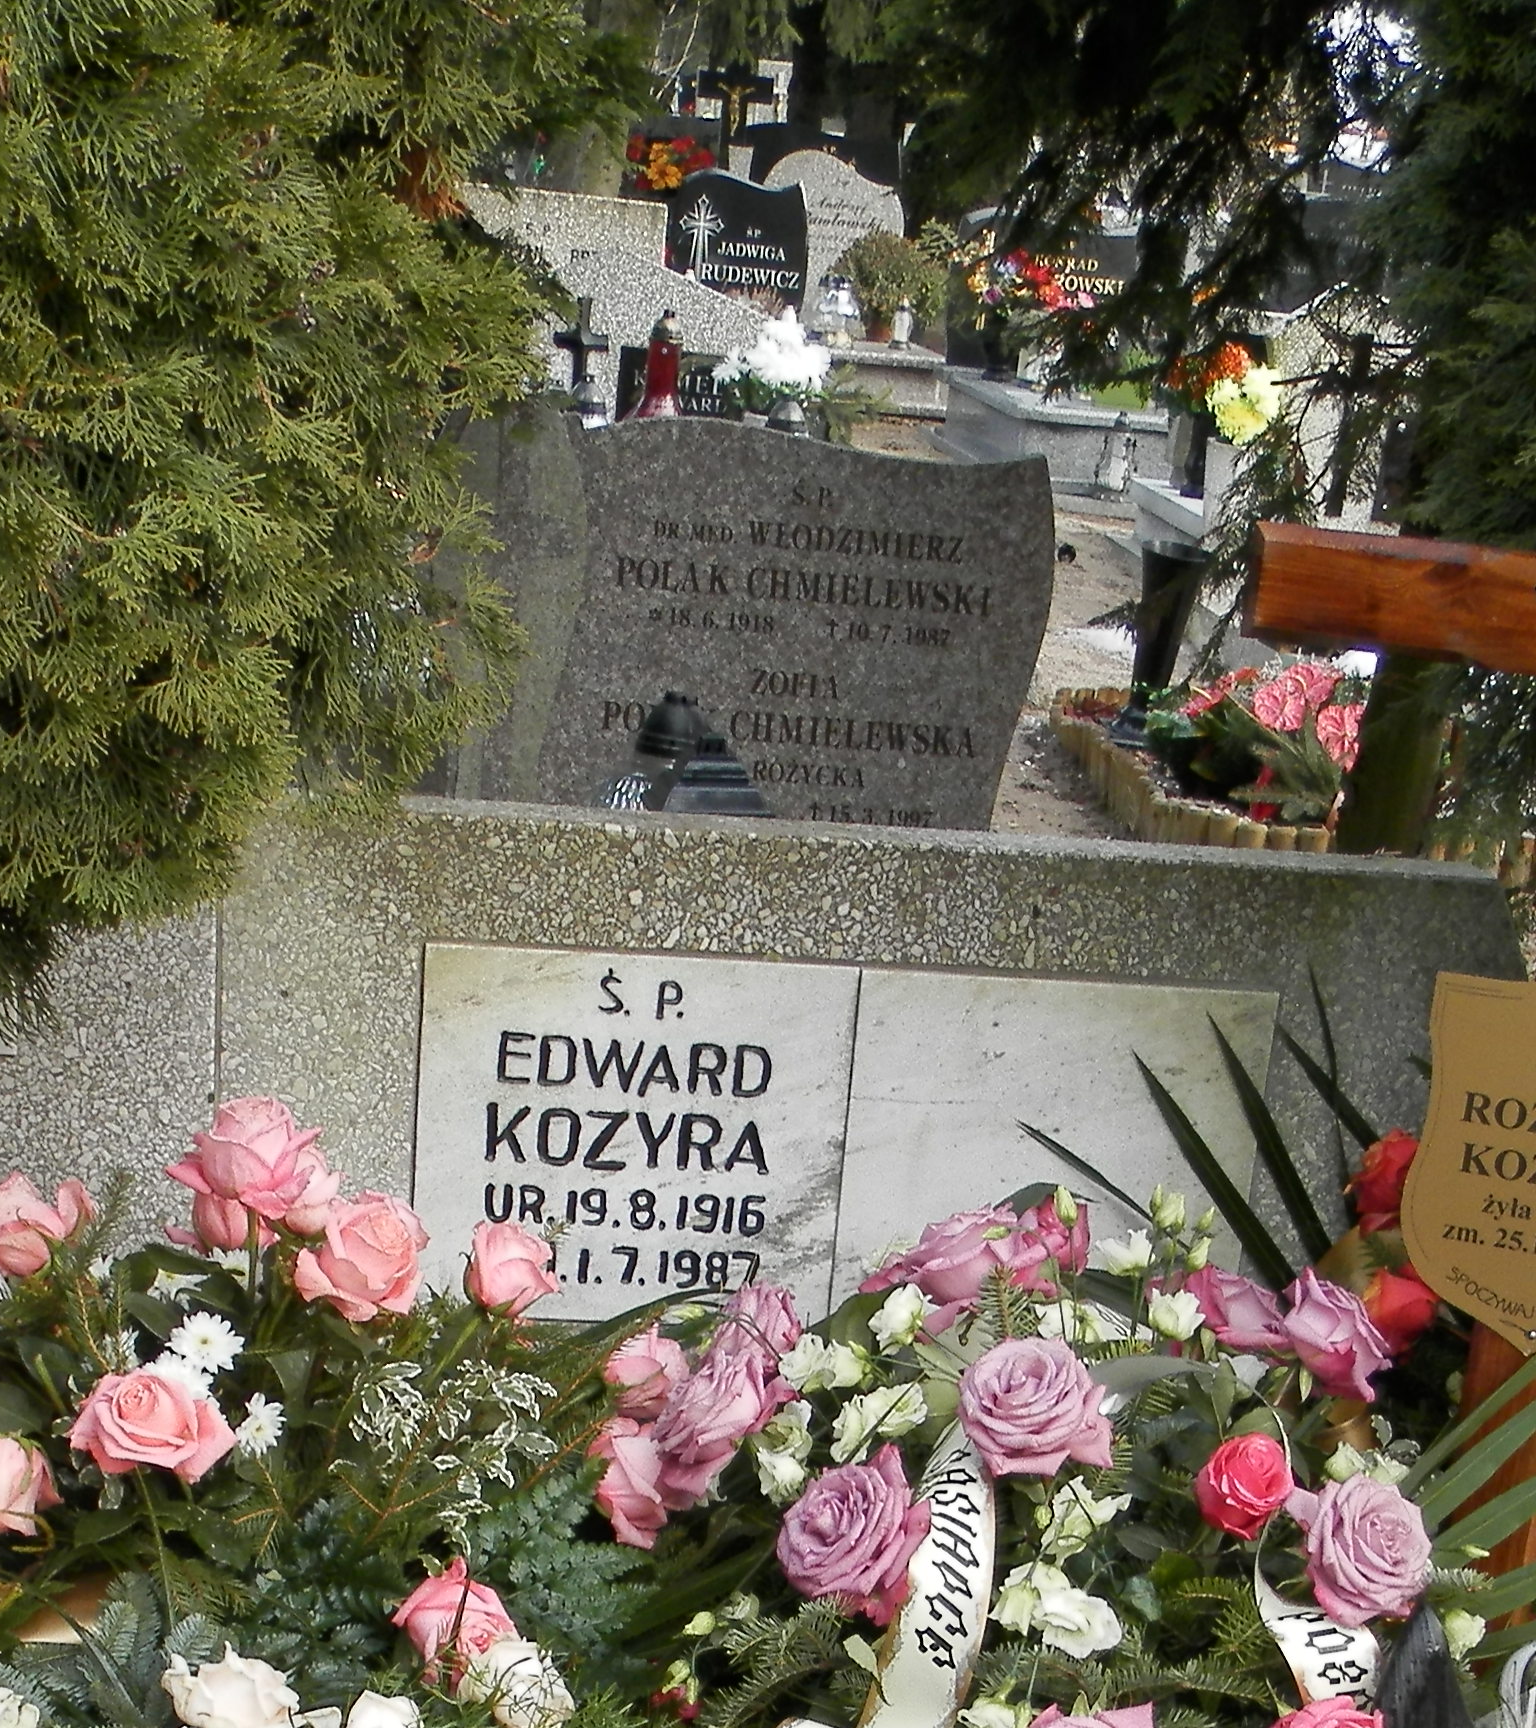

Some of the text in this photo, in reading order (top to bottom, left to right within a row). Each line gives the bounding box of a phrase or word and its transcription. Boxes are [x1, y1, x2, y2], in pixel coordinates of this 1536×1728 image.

[717, 241, 786, 262] JADWIGA
[701, 263, 800, 290] RUDEWICZ
[748, 519, 965, 566] WŁODZIMIERZ
[615, 555, 994, 618] POLAK CHMIELEWSKI
[750, 668, 839, 699] ZOFIA
[730, 708, 977, 760] CHMIELEWSKA
[496, 1030, 773, 1099] EDWARD
[484, 1101, 770, 1177] KOZYRA
[1481, 1193, 1532, 1221] żyła
[1441, 1222, 1486, 1246] zm.
[1445, 1265, 1535, 1320] SPOCZYWAJ
